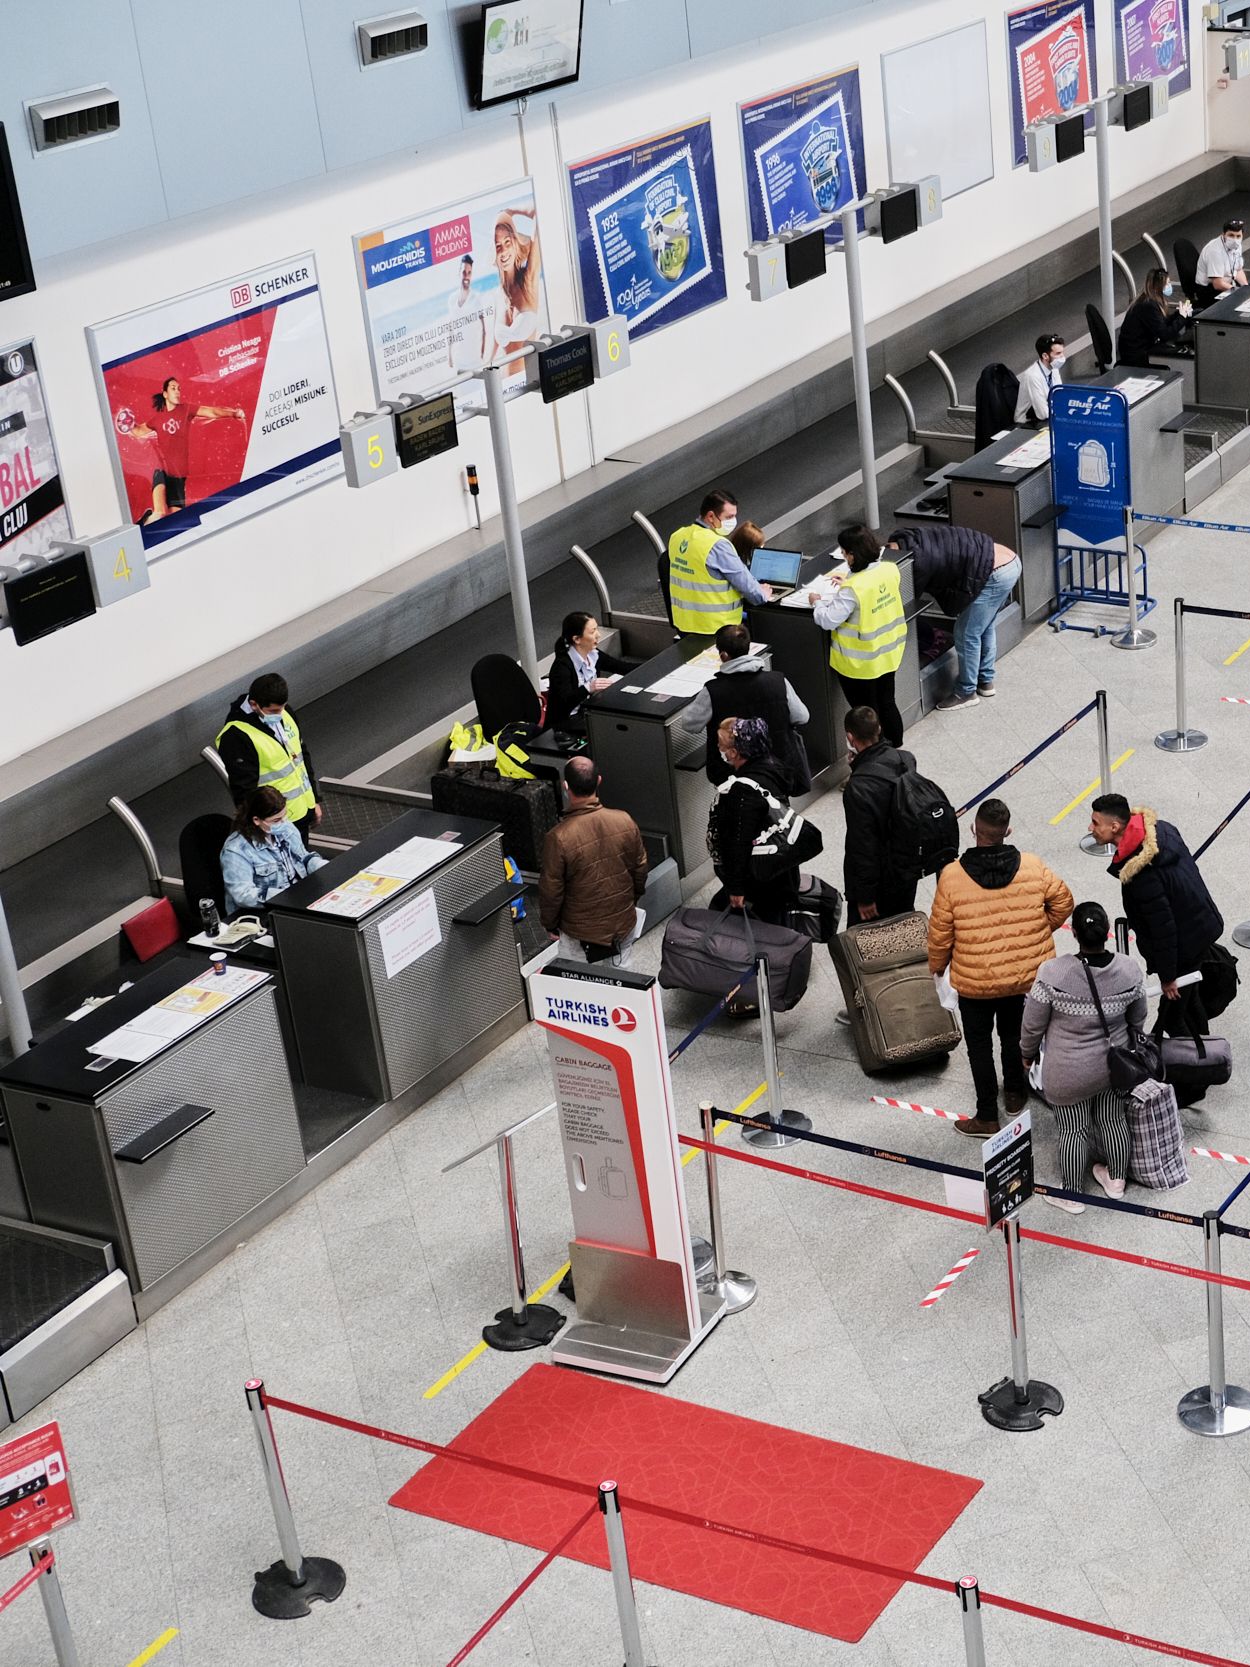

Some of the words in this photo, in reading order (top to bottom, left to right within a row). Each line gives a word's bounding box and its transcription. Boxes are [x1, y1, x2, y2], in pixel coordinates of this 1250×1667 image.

[1042, 136, 1051, 160] 9
[766, 152, 780, 171] 1996
[647, 177, 673, 201] FOUNDATION
[928, 188, 937, 212] 8
[601, 212, 620, 233] 1932
[434, 224, 468, 246] AMARA
[435, 237, 469, 258] HOLIDAYS
[371, 246, 426, 275] MOUZENIDIS
[405, 258, 426, 270] TRAVEL
[767, 258, 779, 286] 7
[233, 287, 250, 305] DB
[255, 268, 309, 297] SCHENKER
[218, 341, 242, 357] Cristina
[242, 336, 261, 349] Neagu
[380, 330, 394, 344] VARA
[397, 338, 415, 354] DIRECT
[415, 335, 424, 347] DIN
[424, 330, 437, 343] CLUJ
[607, 332, 620, 362] 6
[384, 354, 409, 372] EXCLUSIV
[409, 350, 417, 362] CU
[416, 338, 447, 359] MOUZENIDIS
[447, 332, 464, 346] TRAVEL
[546, 353, 572, 369] Thomas
[572, 346, 588, 359] Cook
[219, 367, 229, 377] DB
[228, 357, 257, 373] Schenker
[1068, 399, 1093, 408] Blue
[1094, 402, 1111, 410] Air
[261, 412, 300, 436] SUCCESUL
[367, 434, 384, 469] 5
[3, 502, 29, 537] CLUJ
[114, 547, 132, 582] 4
[561, 971, 579, 980] STAR
[580, 973, 614, 986] ALLIANCE
[545, 997, 607, 1016] TURKISH
[548, 1008, 609, 1027] AIRLINES
[555, 1056, 577, 1065] CABIN
[578, 1060, 612, 1071] BAGGAGE
[740, 1117, 771, 1130] Lufthansa
[991, 1129, 1012, 1148] TURKISH
[992, 1135, 1013, 1153] AIRLINES
[874, 1150, 907, 1163] Lufthansa
[986, 1156, 1007, 1177] PRIORITY
[1007, 1140, 1030, 1161] BOARDING
[1158, 1211, 1193, 1224] Lufthansa
